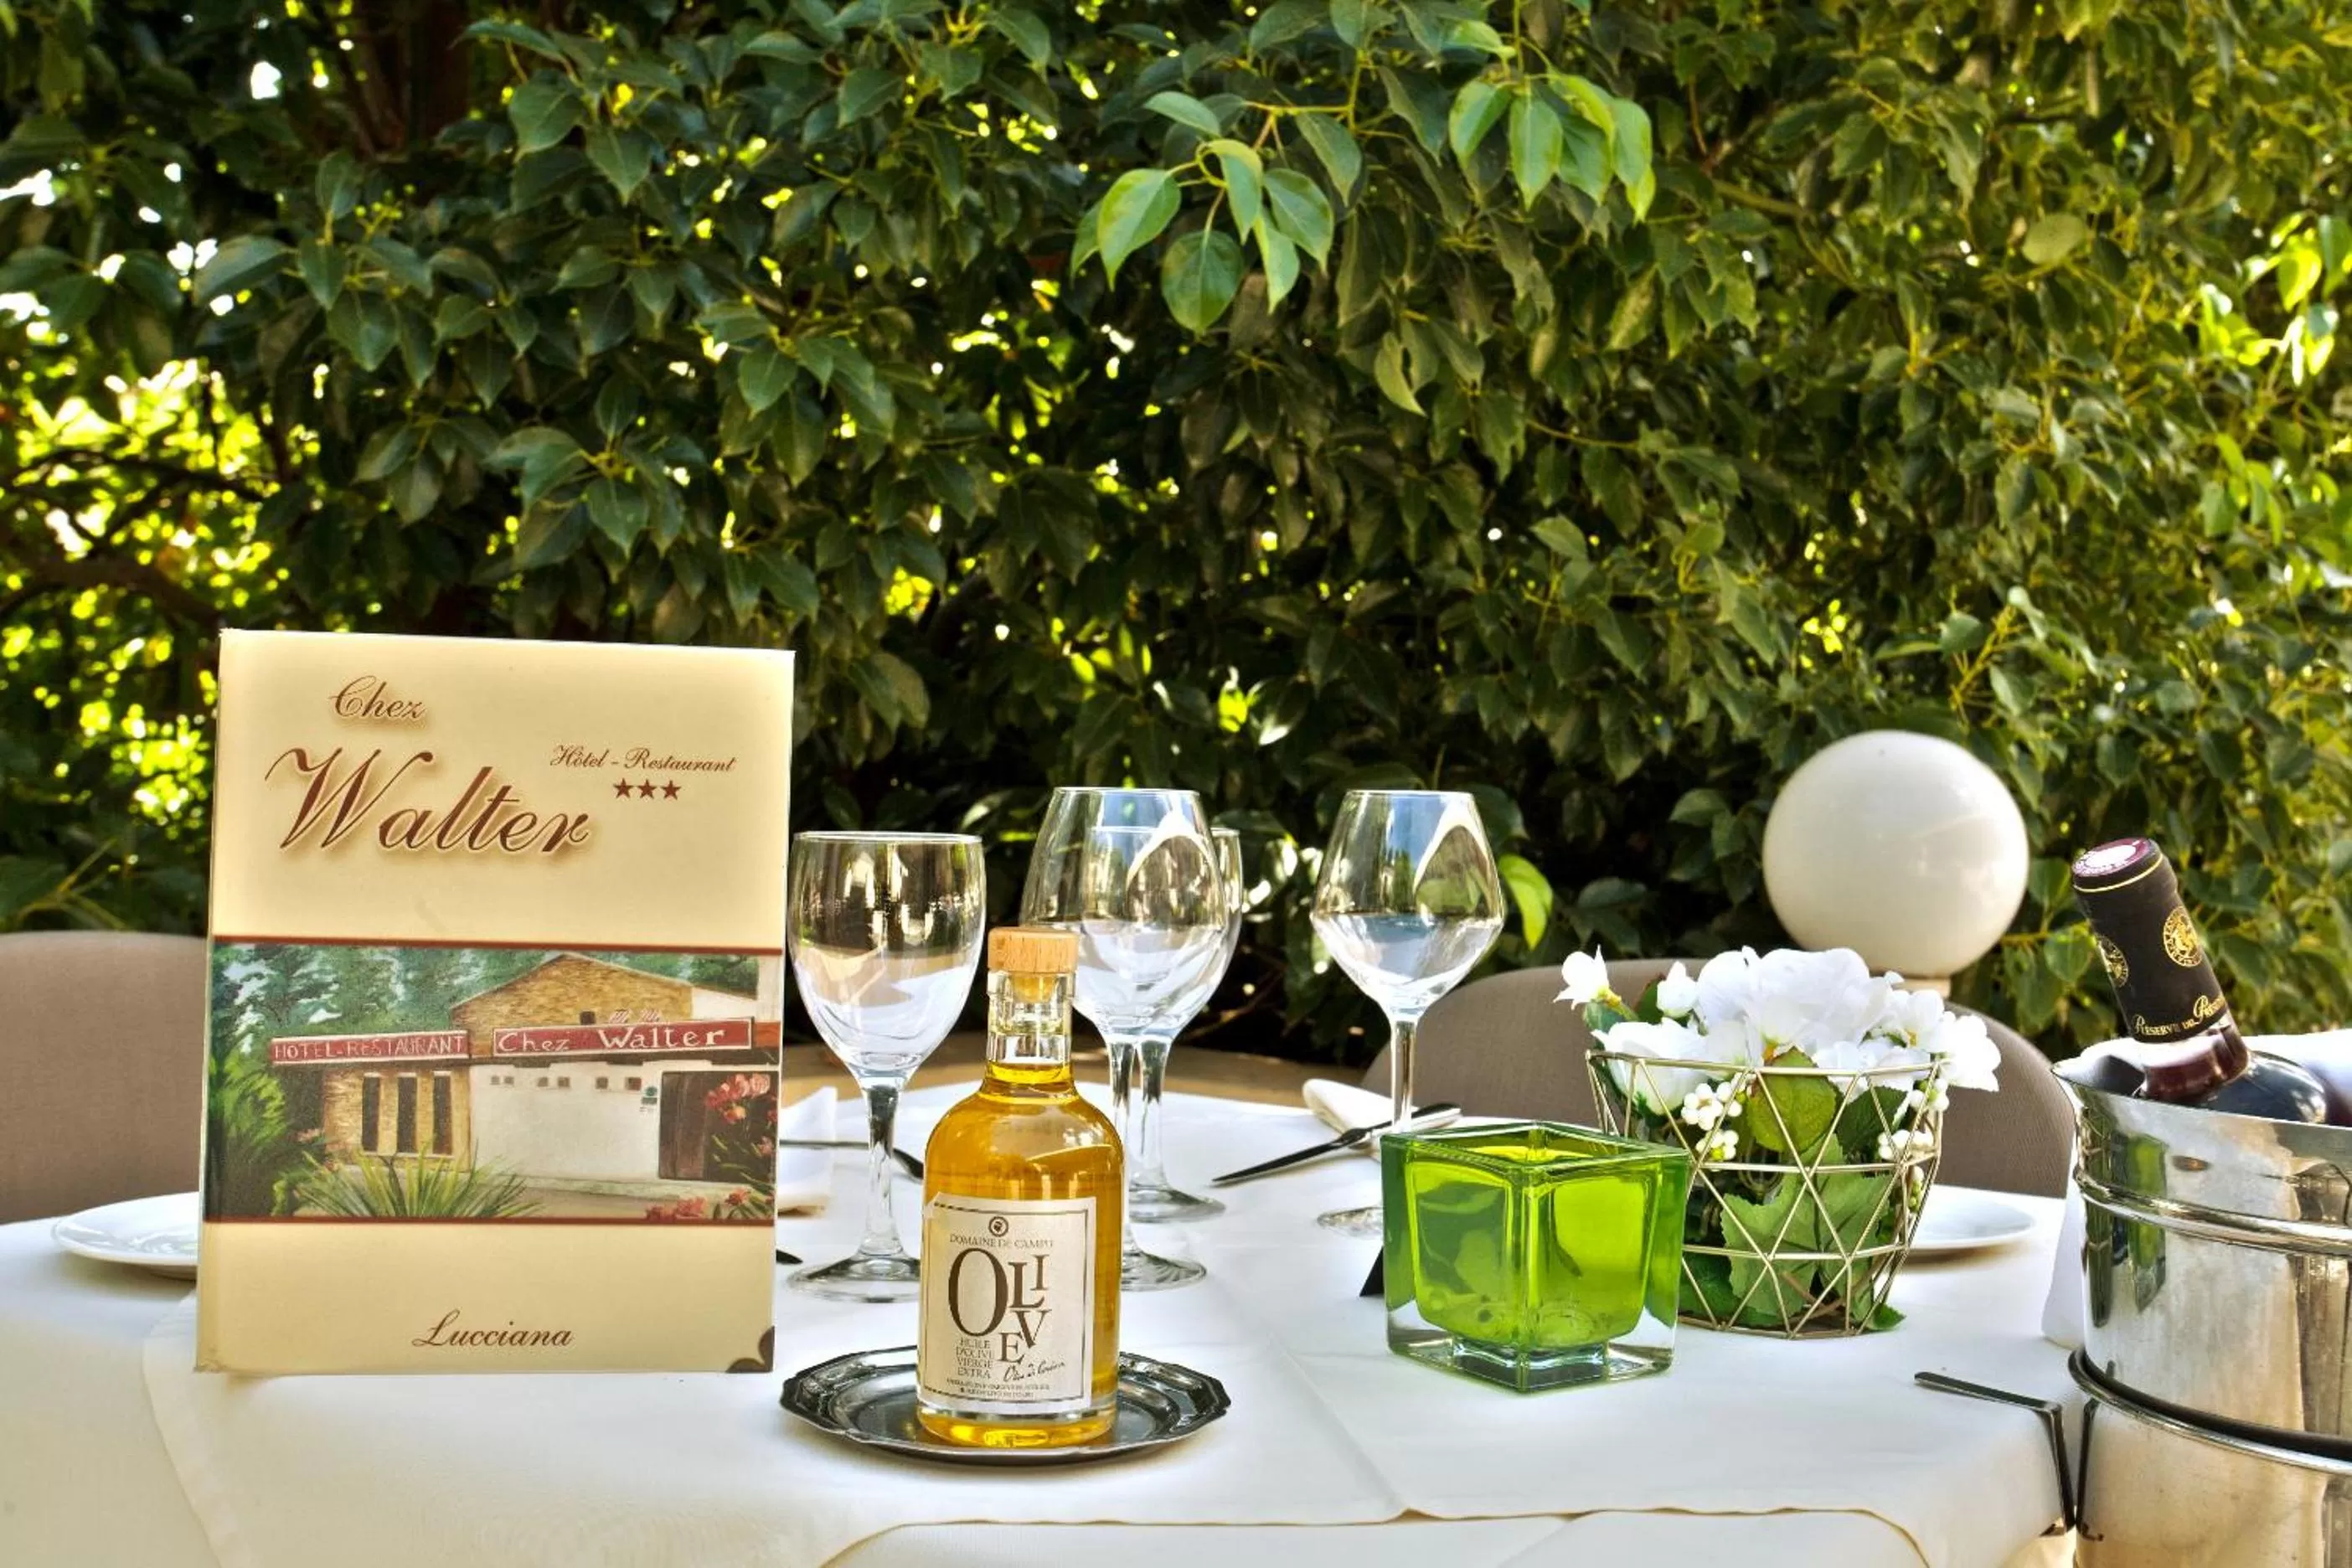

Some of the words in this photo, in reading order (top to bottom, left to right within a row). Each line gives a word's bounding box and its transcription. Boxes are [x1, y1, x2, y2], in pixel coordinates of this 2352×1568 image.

[328, 675, 426, 719] Chez
[550, 745, 610, 768] Hôtel
[623, 747, 737, 772] Restaurant
[265, 747, 590, 854] Walter
[498, 1031, 570, 1053] Chez
[597, 1027, 726, 1049] Walter
[950, 1234, 996, 1247] DOMAINE
[411, 1308, 574, 1348] Lucciana
[958, 1368, 992, 1380] EXTRA
